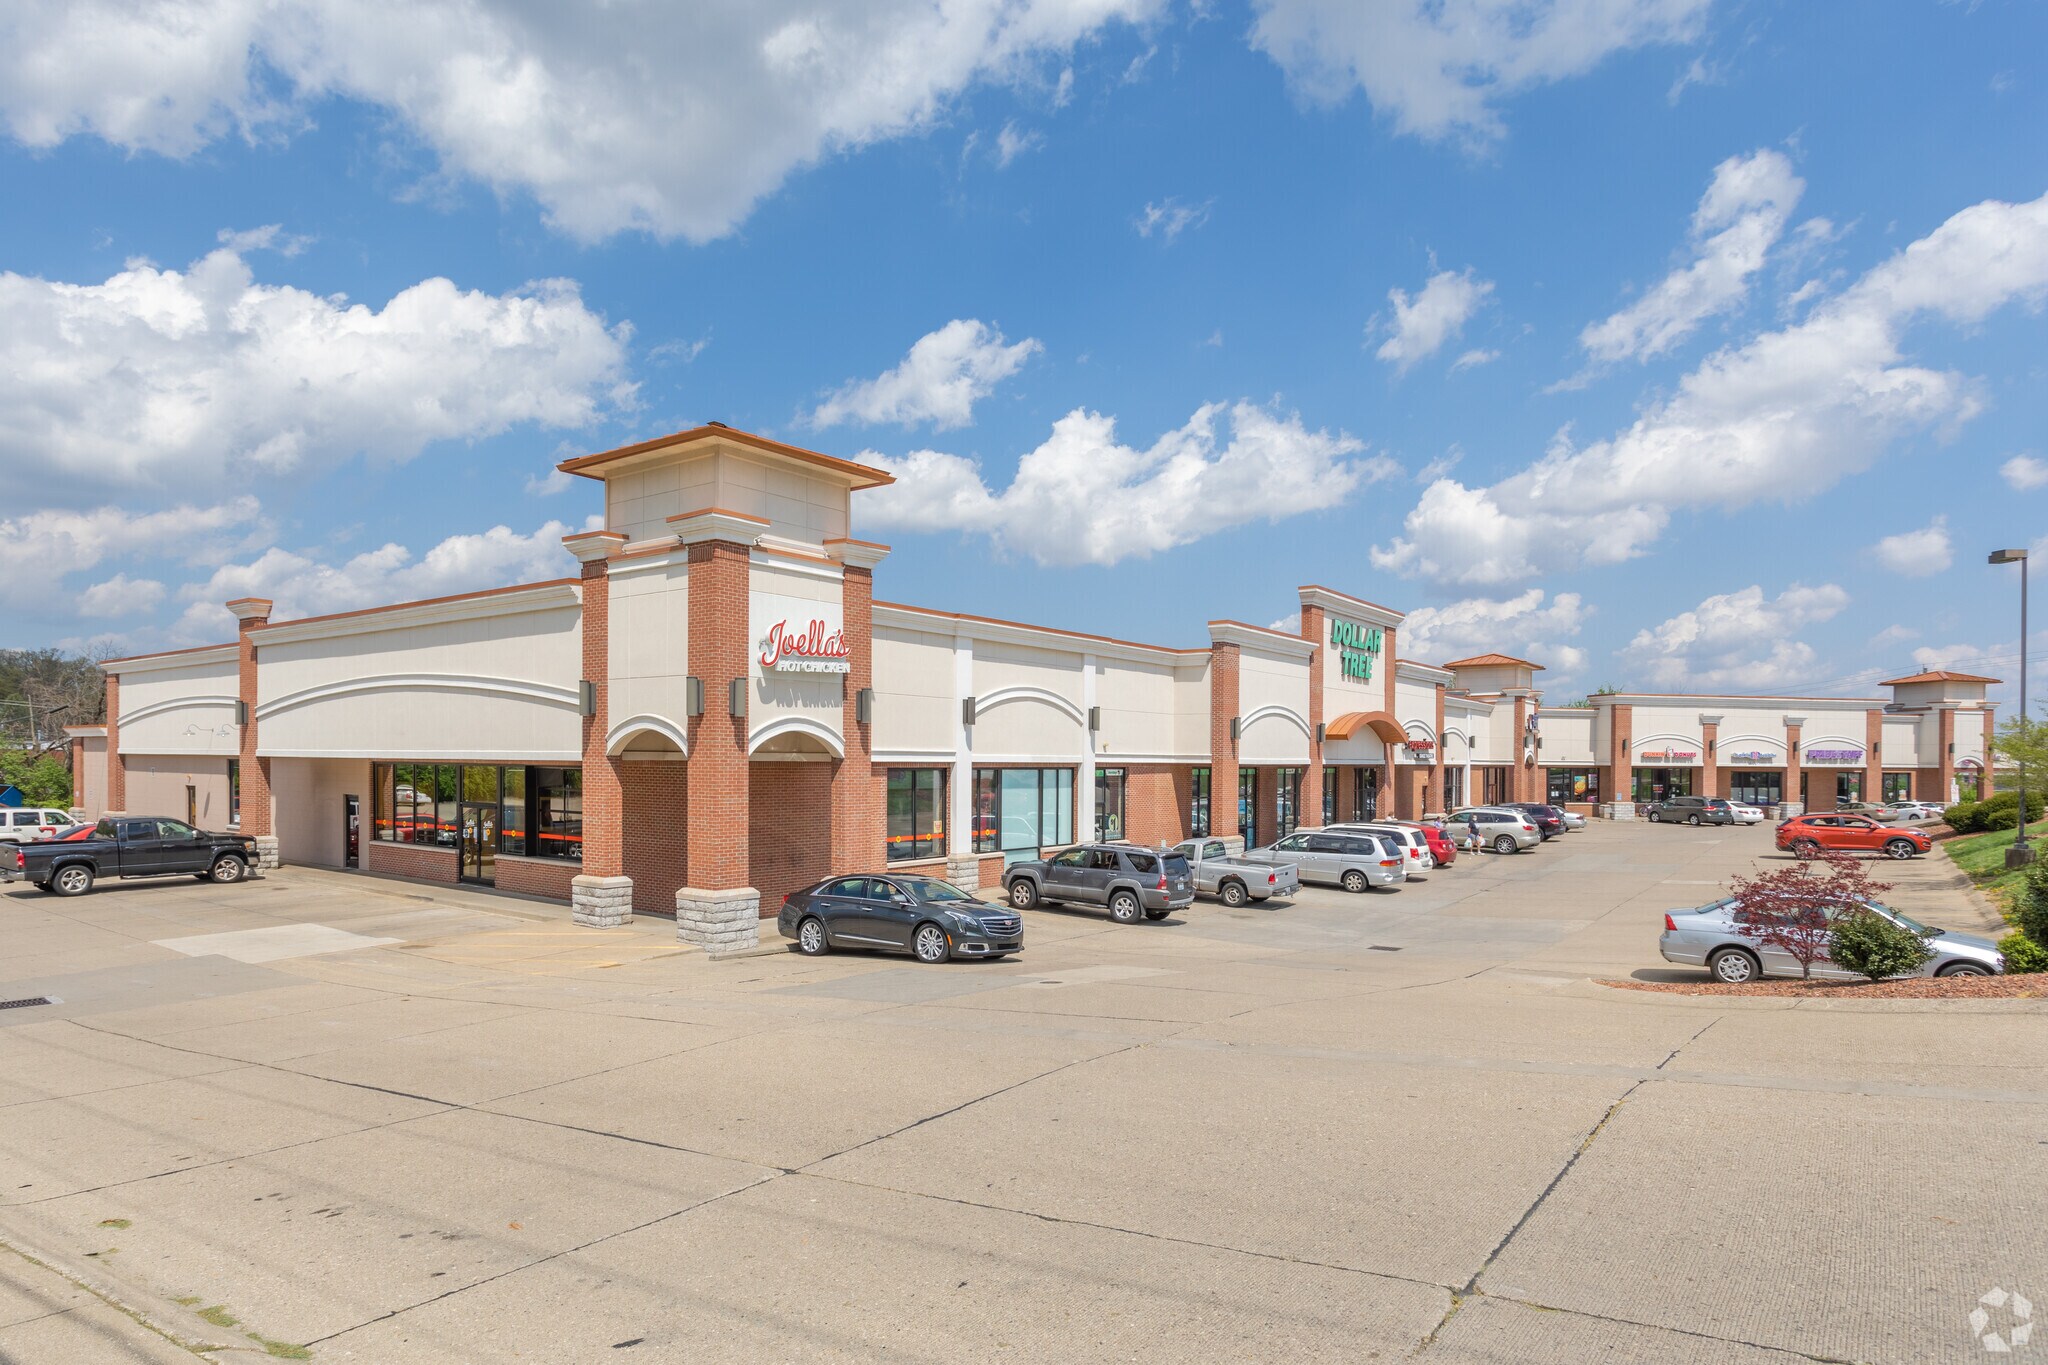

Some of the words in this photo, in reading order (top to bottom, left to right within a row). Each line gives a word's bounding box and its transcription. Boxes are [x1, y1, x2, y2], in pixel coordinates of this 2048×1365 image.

[759, 619, 852, 667] Joella's
[1331, 619, 1382, 653] DOLLAR
[777, 660, 803, 673] HOT
[803, 661, 851, 673] CHICKEN
[1341, 651, 1373, 679] TREE
